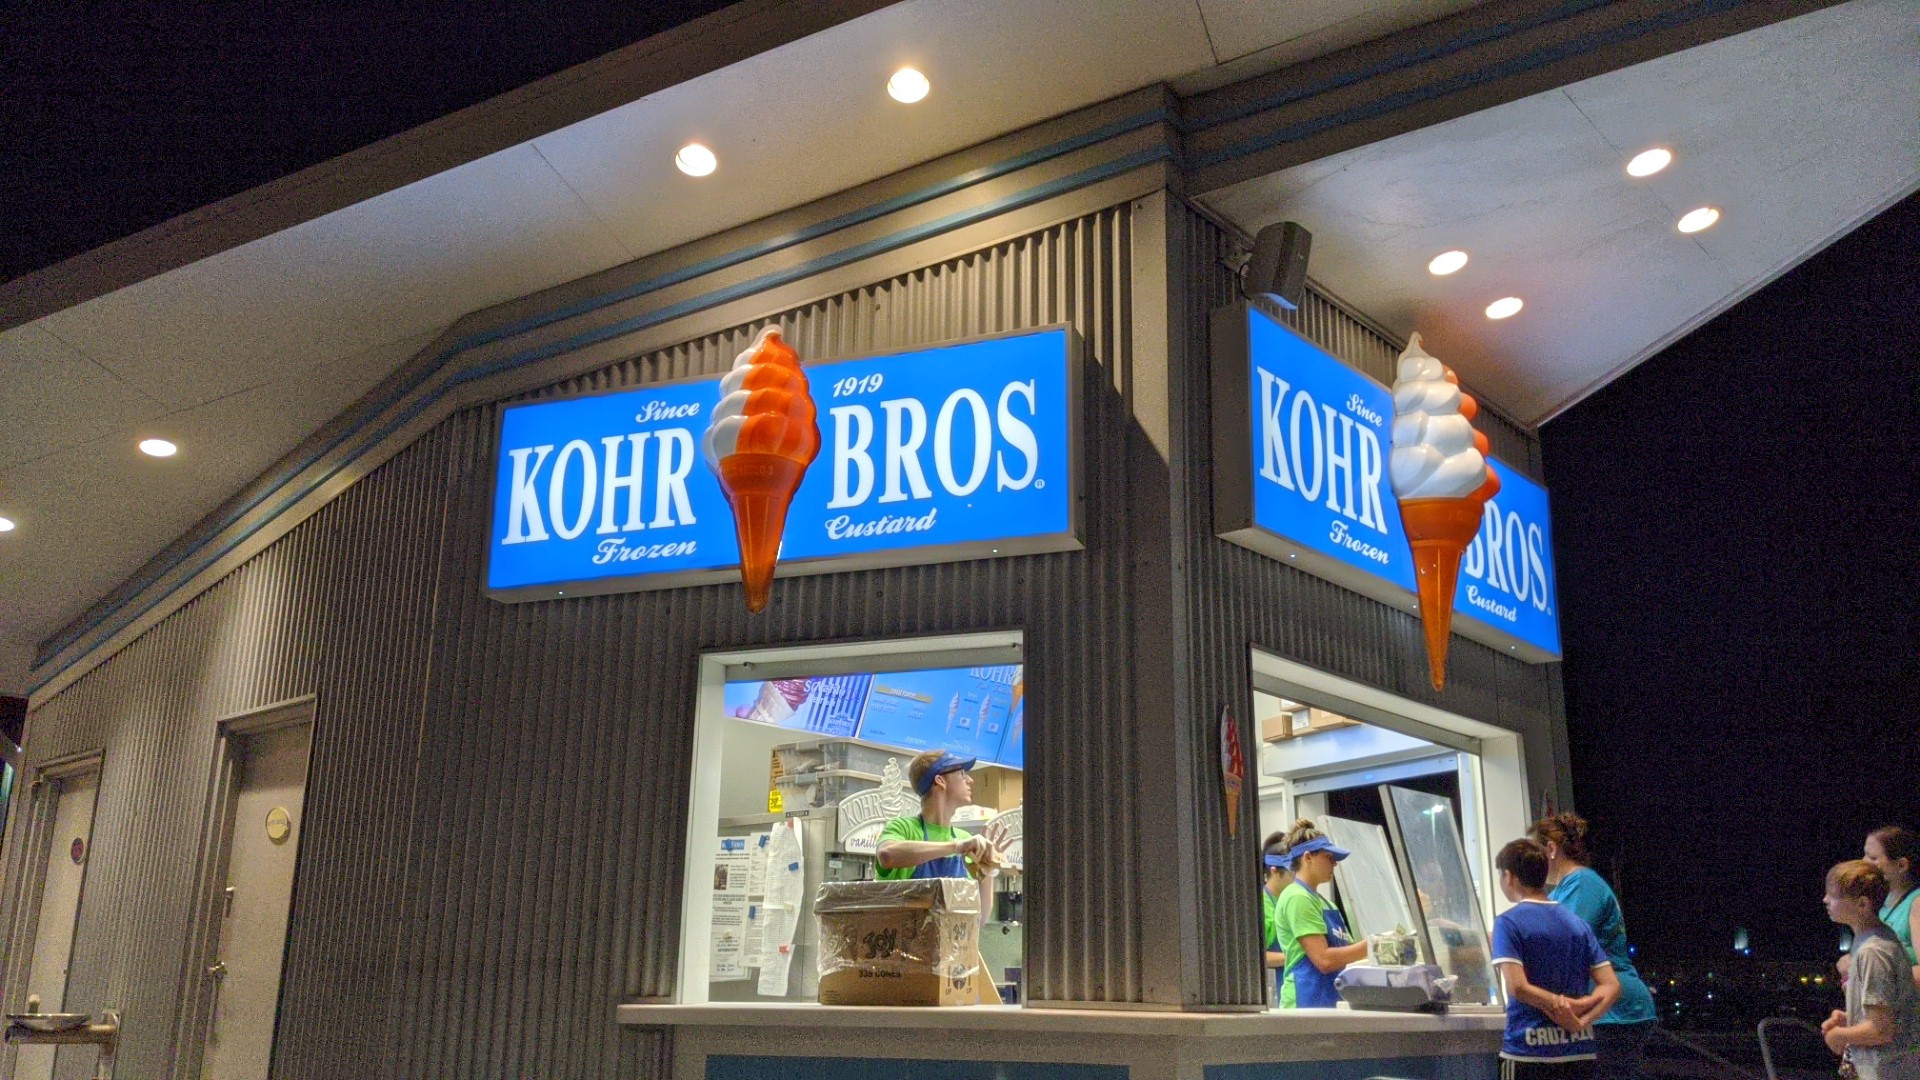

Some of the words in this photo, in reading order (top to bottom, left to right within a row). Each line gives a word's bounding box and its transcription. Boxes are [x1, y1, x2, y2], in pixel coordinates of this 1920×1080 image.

[635, 400, 700, 423] Since
[832, 373, 884, 398] 1919
[1346, 393, 1383, 427] Since
[501, 427, 697, 545] KOHR
[826, 378, 1039, 510] BROS
[1256, 365, 1388, 535] KOHR
[591, 537, 697, 565] Frozen
[825, 507, 937, 540] Custard
[1329, 519, 1390, 565] Frozen
[1465, 584, 1517, 622] Custard
[850, 833, 878, 849] vanill
